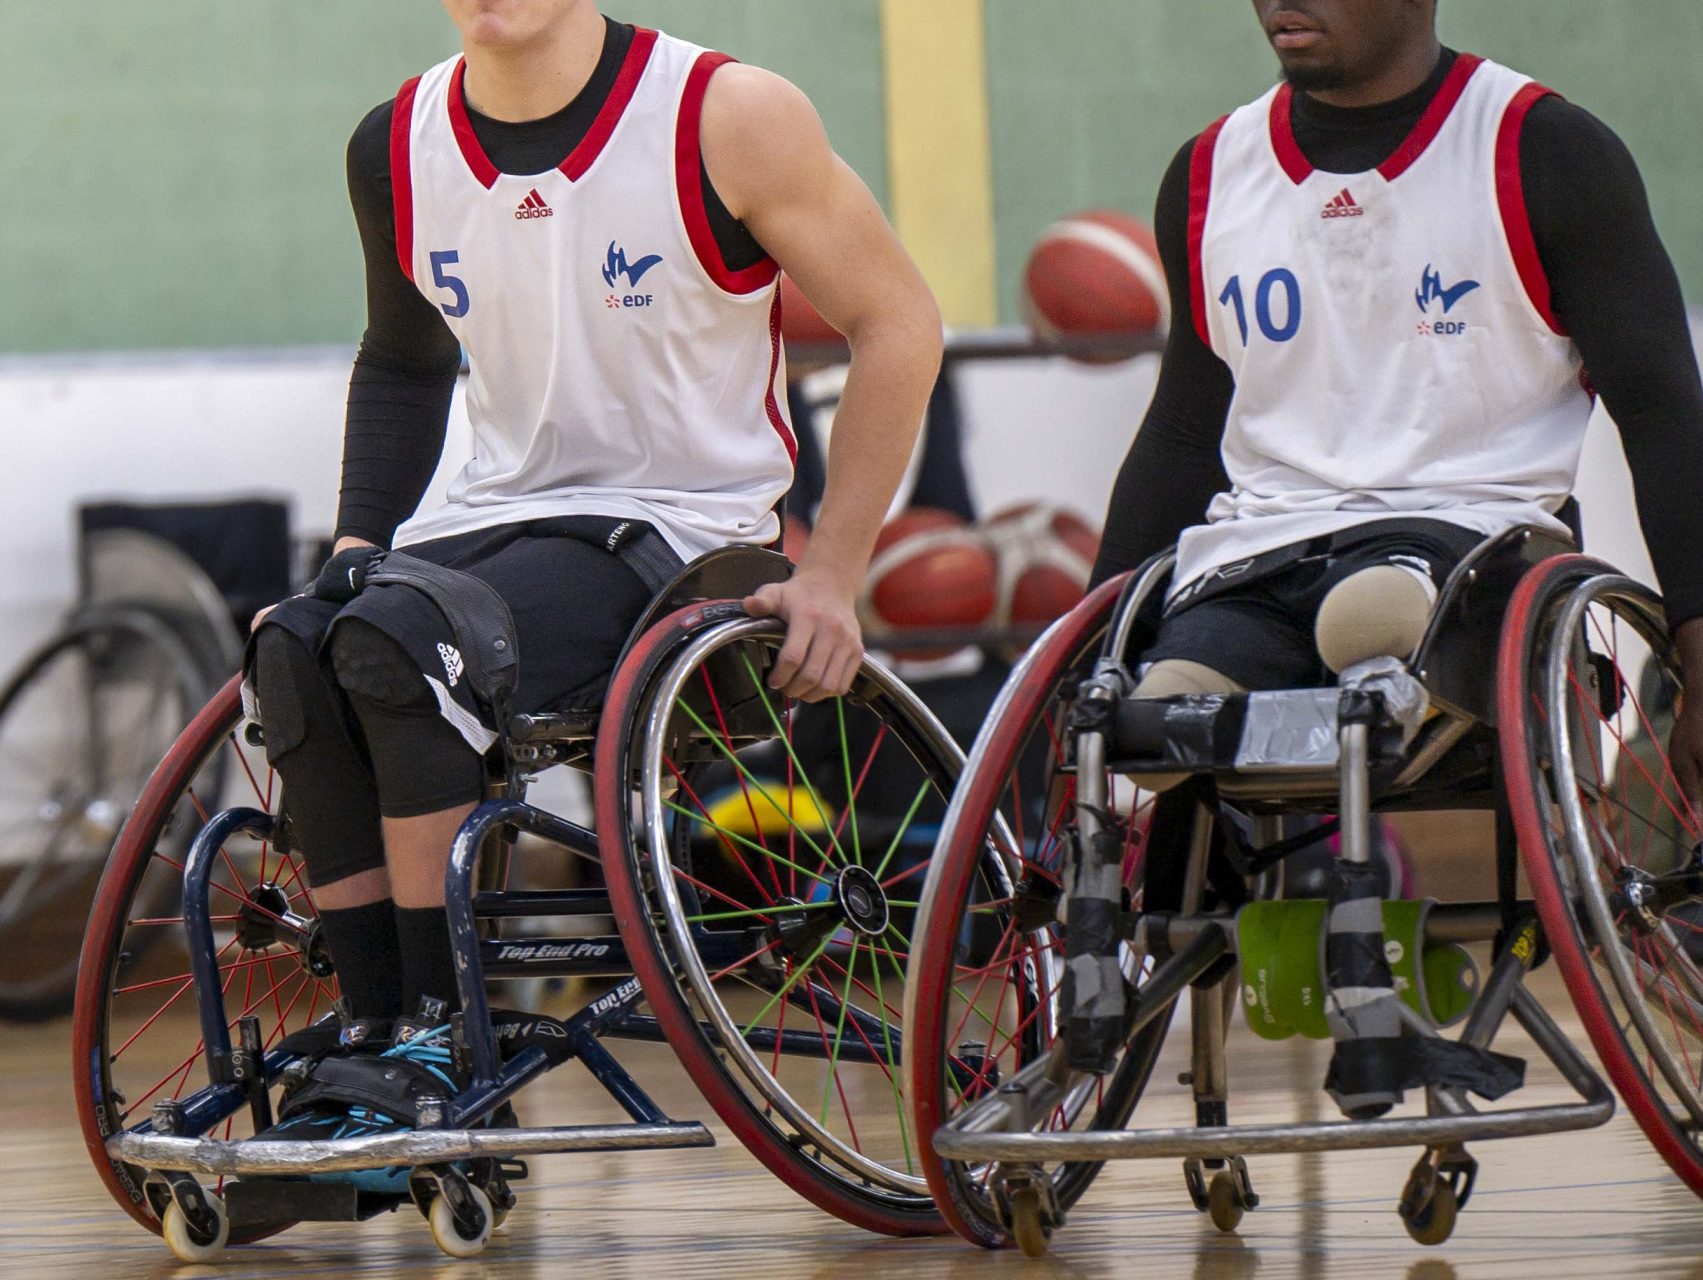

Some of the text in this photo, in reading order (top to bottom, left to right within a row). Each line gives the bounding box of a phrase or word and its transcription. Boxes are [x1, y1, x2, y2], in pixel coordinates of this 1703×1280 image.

[515, 207, 553, 220] adidas
[1321, 207, 1364, 219] adidas
[429, 250, 470, 318] 5
[1218, 267, 1301, 347] 10
[437, 642, 457, 687] adidas
[498, 943, 610, 960] Top End Pro
